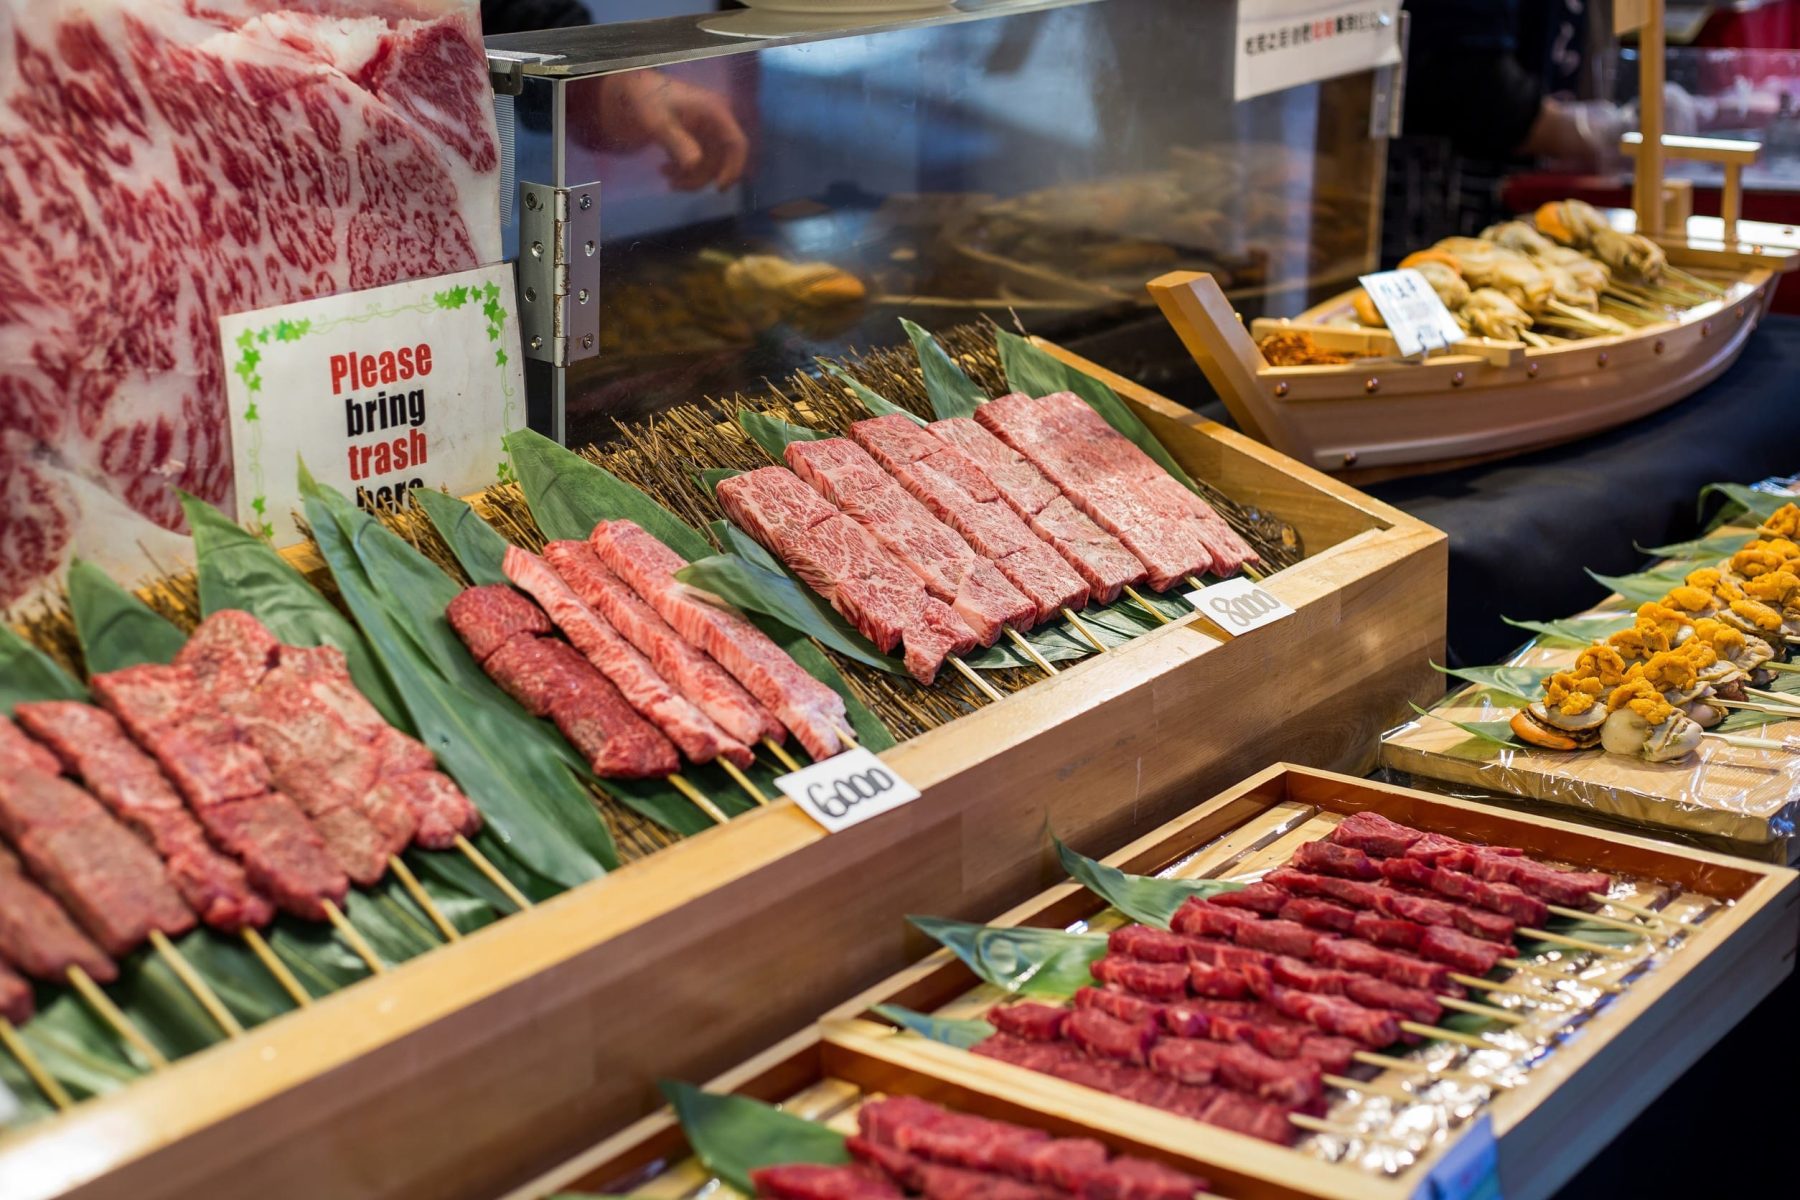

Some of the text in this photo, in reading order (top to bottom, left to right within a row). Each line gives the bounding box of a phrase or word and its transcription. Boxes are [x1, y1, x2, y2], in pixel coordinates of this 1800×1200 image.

[330, 343, 433, 395] Please
[345, 389, 426, 437] bring
[348, 428, 428, 481] trash
[1209, 588, 1281, 627] 8000
[807, 768, 895, 818] 6000
